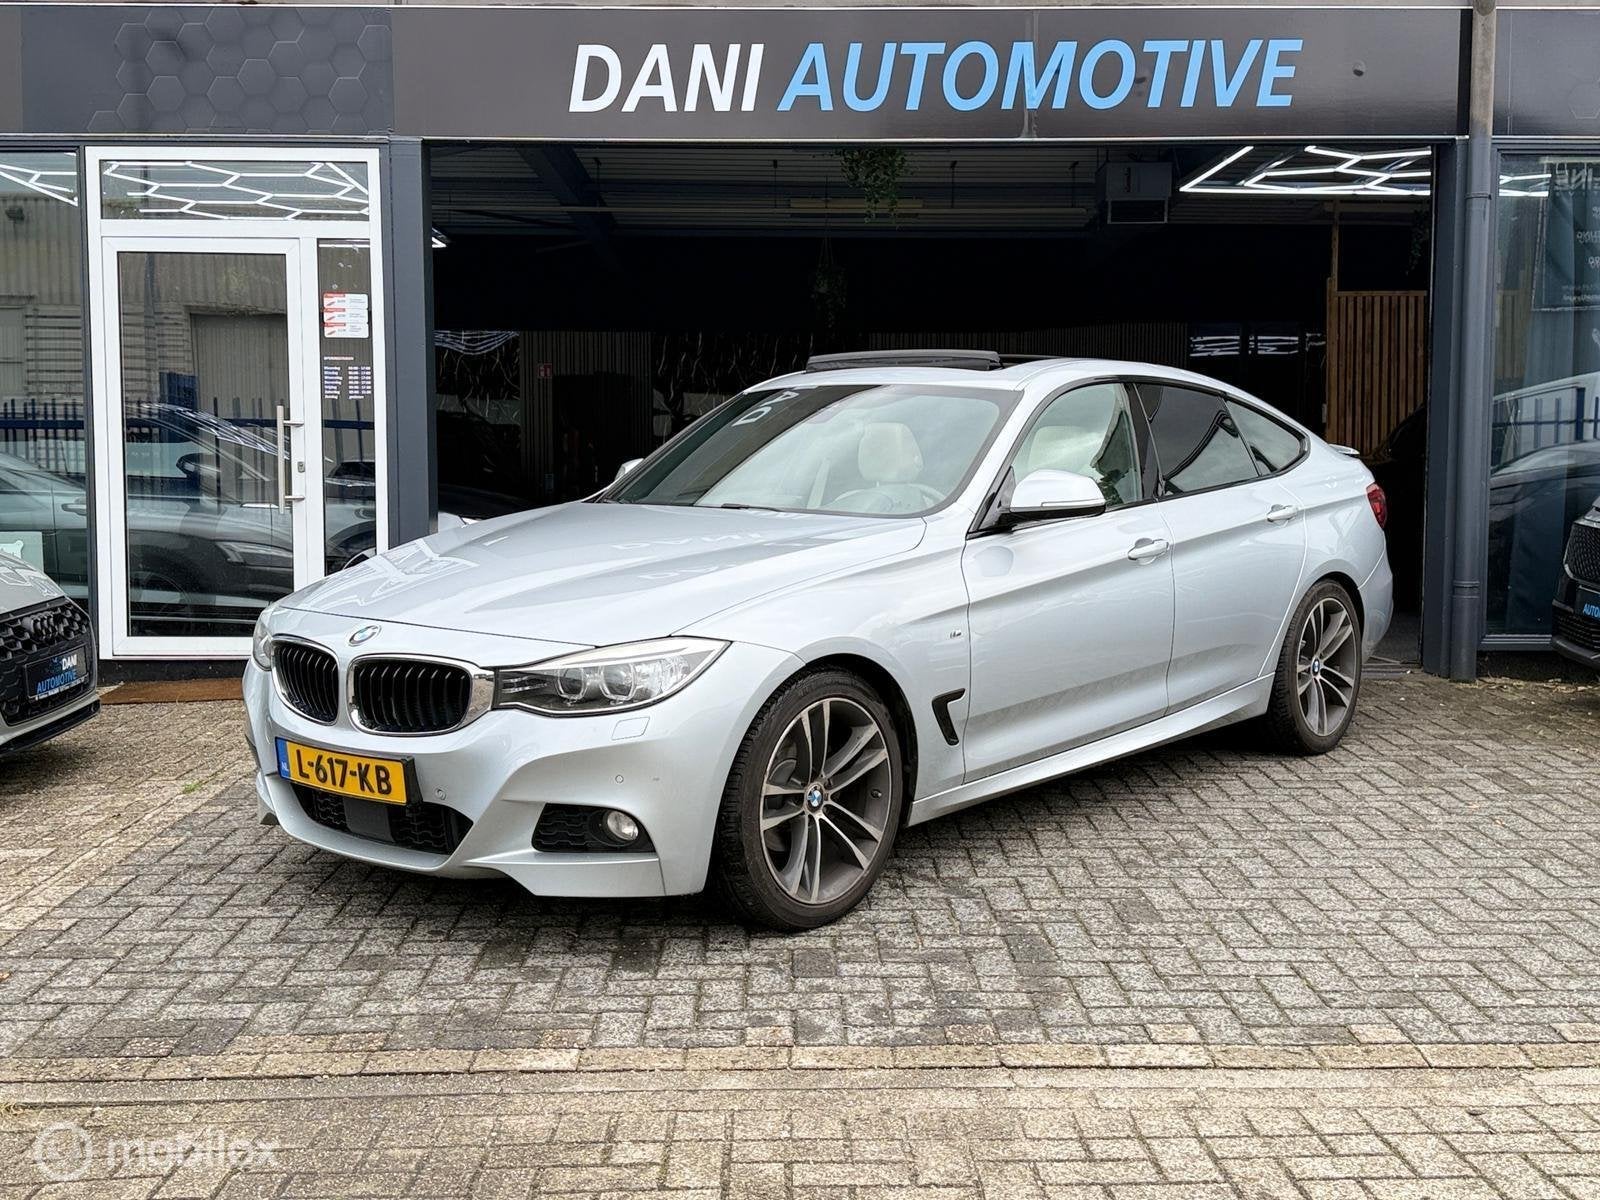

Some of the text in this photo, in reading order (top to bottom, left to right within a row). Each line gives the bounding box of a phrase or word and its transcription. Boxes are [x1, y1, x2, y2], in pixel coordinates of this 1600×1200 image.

[568, 39, 1304, 112] DANI AUTOMOTIVE
[36, 669, 77, 695] AUTOMOTIVE
[296, 749, 392, 795] L-617-KB
